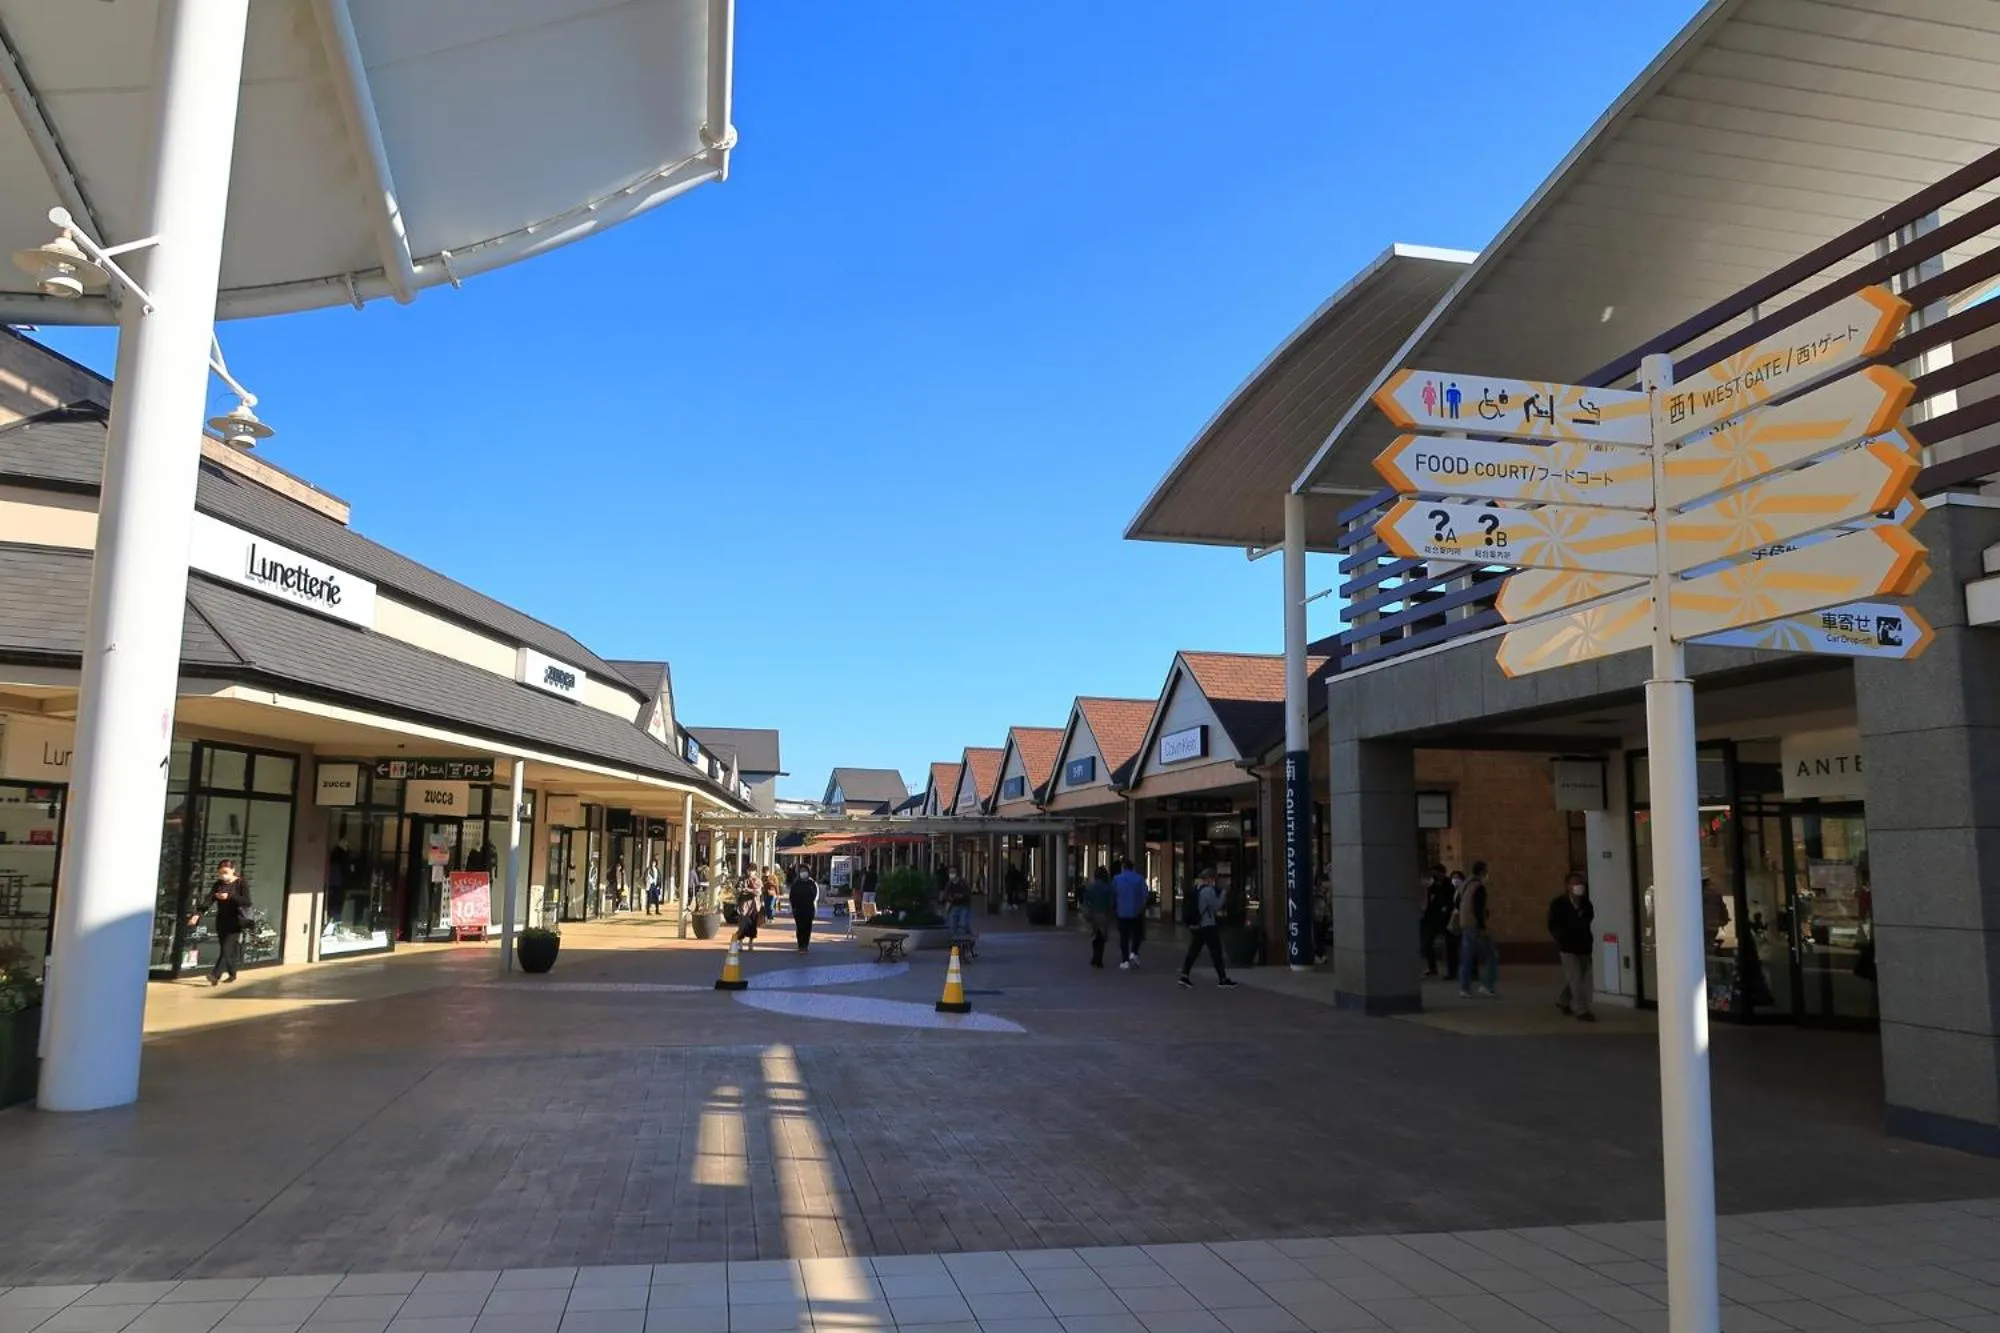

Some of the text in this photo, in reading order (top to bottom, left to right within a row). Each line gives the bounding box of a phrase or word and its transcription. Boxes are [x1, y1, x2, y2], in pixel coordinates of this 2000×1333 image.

[1702, 376, 1742, 409] WEST
[1415, 453, 1469, 475] FOOD
[249, 543, 342, 605] Lunetterie
[1822, 612, 1871, 632] 車寄せ
[1797, 754, 1862, 777] ANTE
[424, 789, 454, 806] zucca
